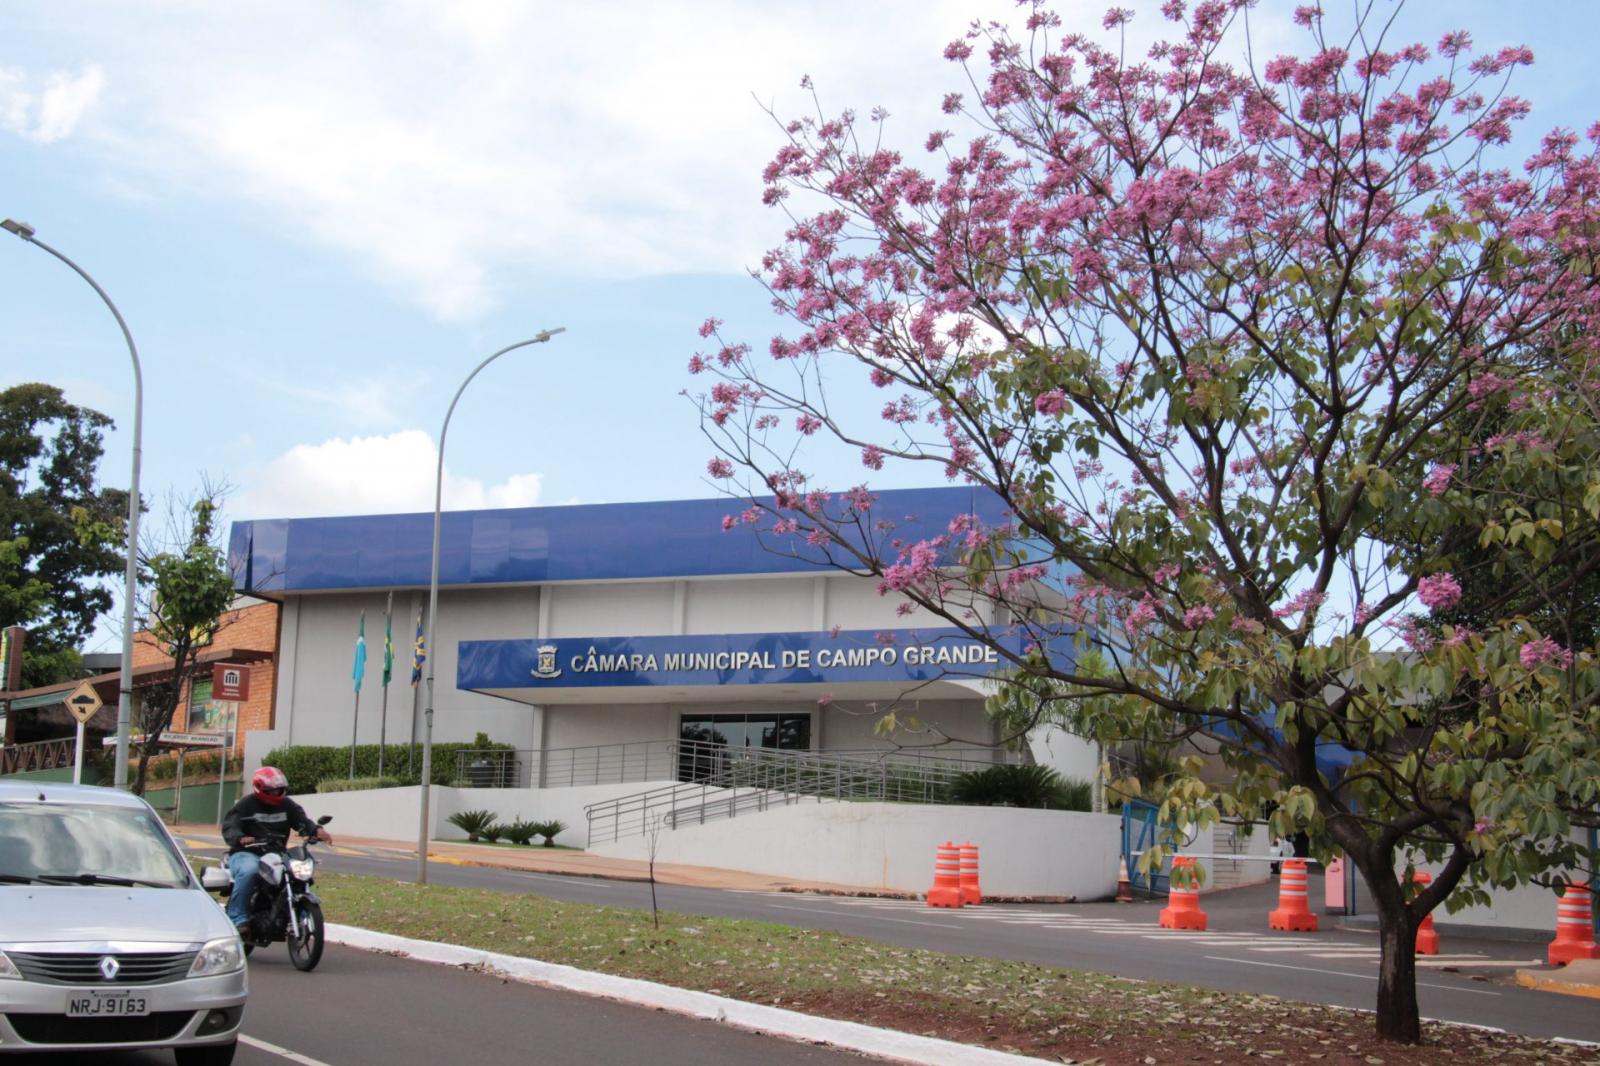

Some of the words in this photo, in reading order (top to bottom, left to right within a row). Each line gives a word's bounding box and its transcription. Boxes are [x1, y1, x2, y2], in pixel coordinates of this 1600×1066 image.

[570, 645, 659, 674] CÂMARA
[663, 651, 776, 671] MUNICIPAL
[781, 649, 810, 669] DE
[816, 647, 897, 668] CAMPO
[903, 645, 998, 665] GRANDE
